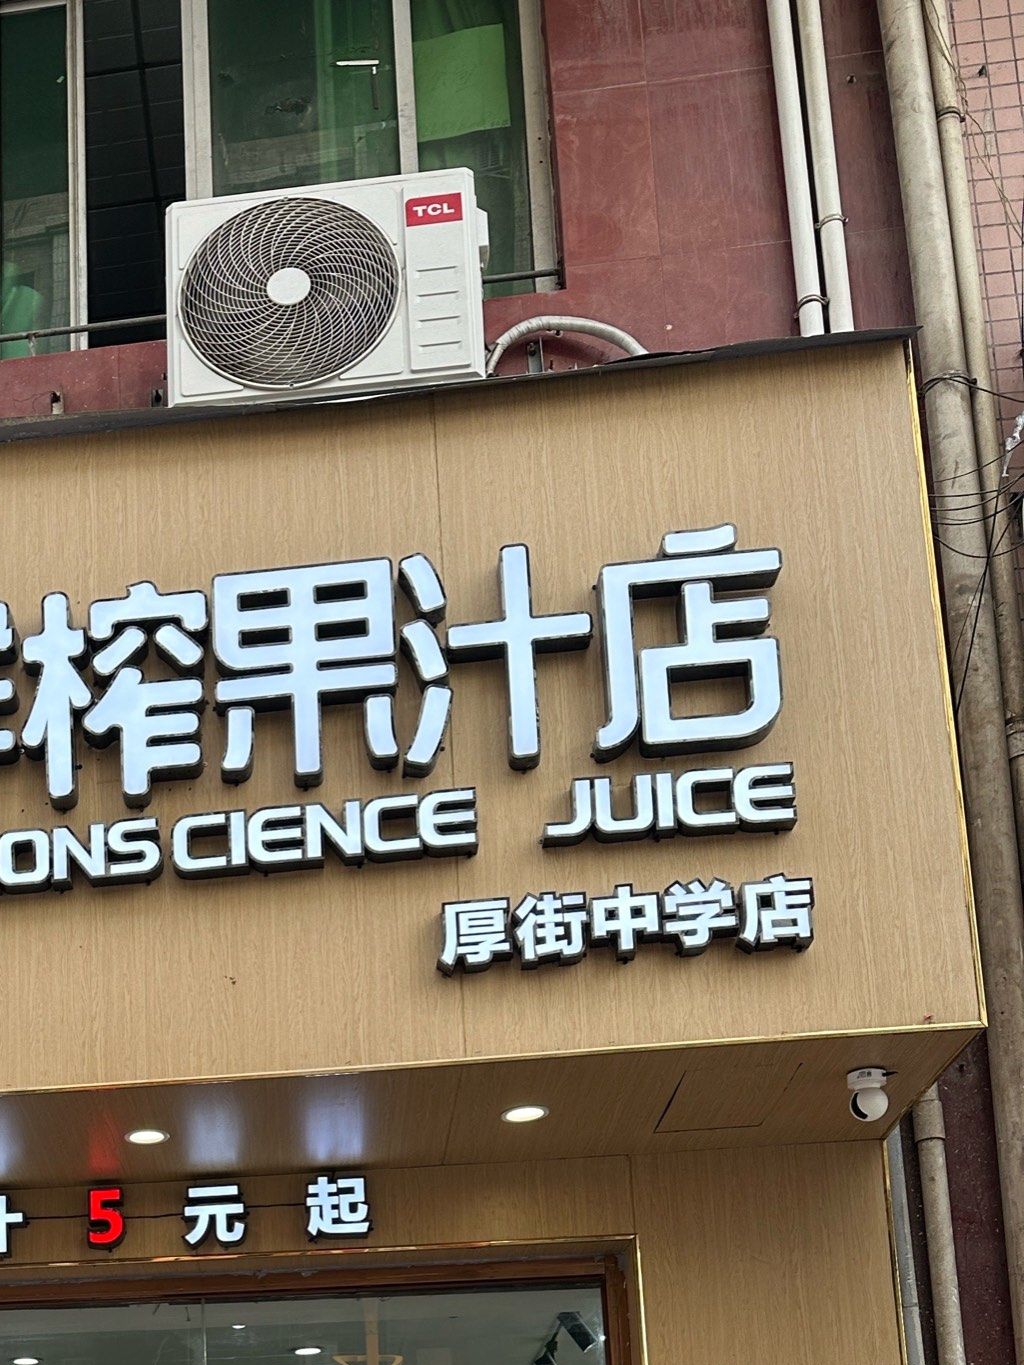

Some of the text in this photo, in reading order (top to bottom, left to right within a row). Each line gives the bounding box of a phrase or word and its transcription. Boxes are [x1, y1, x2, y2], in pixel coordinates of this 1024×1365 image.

[413, 203, 455, 217] TCL
[541, 762, 796, 847] JUICE
[437, 874, 814, 978] 厚街中学店
